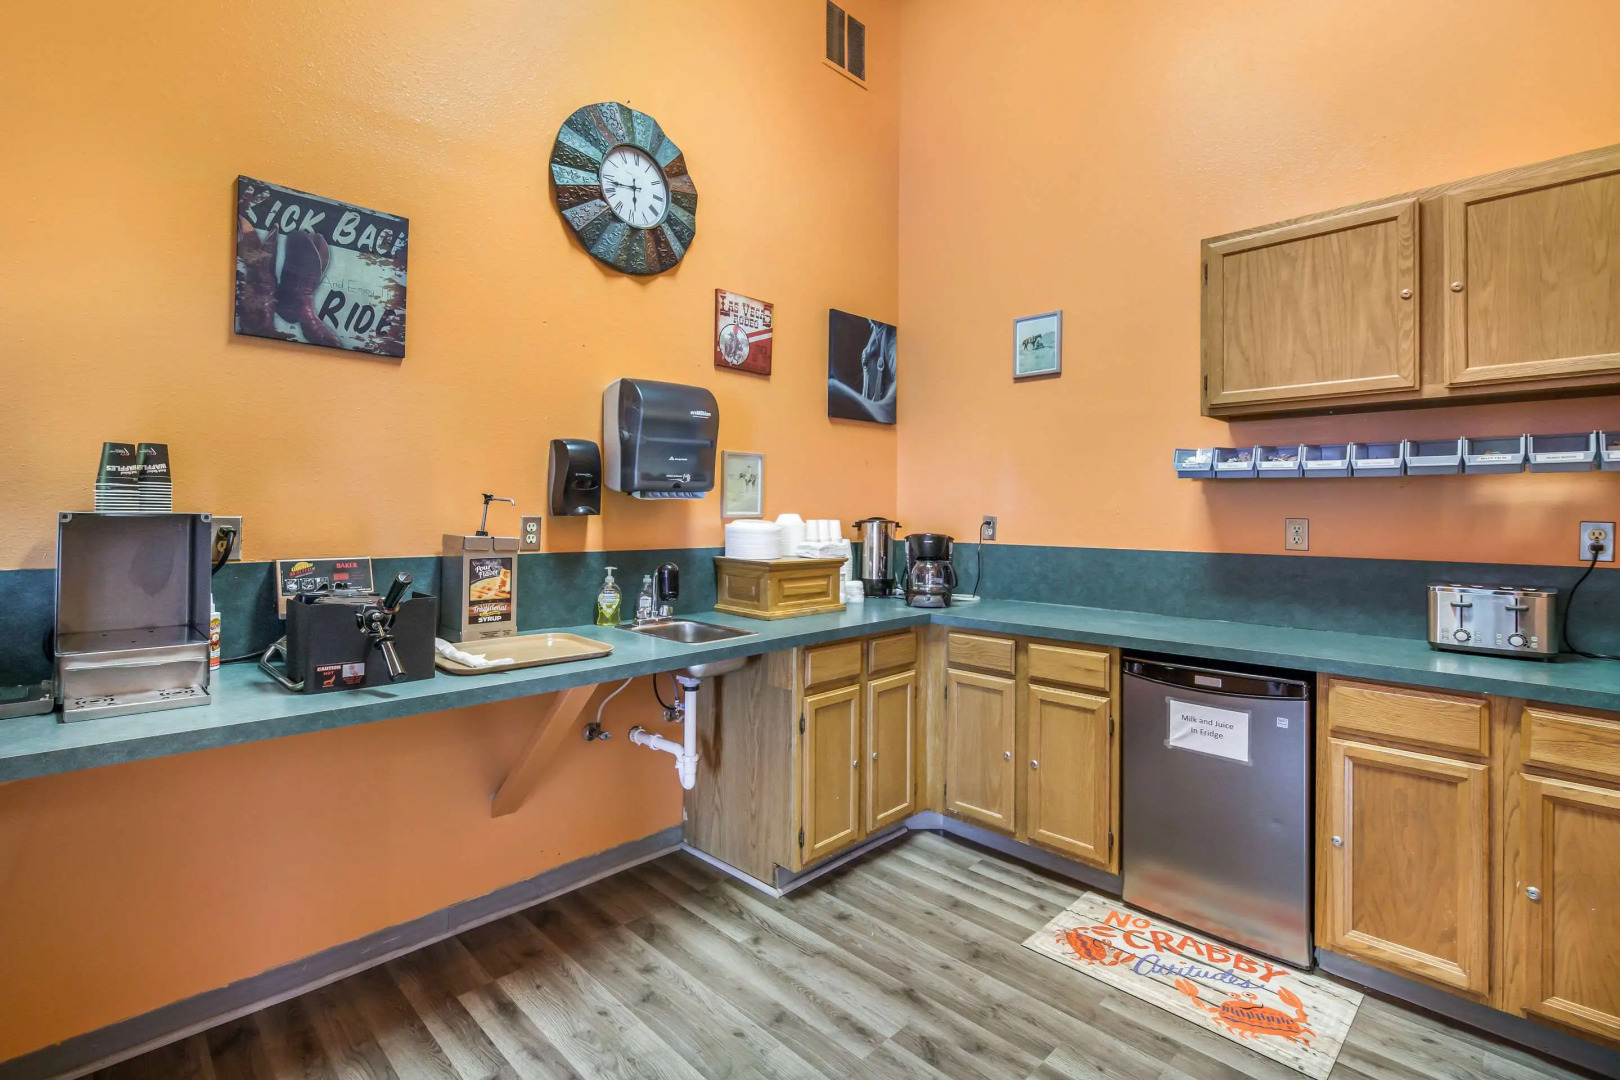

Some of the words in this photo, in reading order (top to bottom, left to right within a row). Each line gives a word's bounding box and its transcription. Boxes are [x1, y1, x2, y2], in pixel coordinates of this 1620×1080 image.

[720, 292, 740, 317] LAS
[733, 313, 759, 329] RODEO
[1181, 713, 1197, 724] Milk
[1199, 717, 1213, 727] and
[1215, 719, 1234, 730] Juice
[1122, 929, 1291, 984] CRABBY
[1132, 953, 1266, 990] Attitudes
